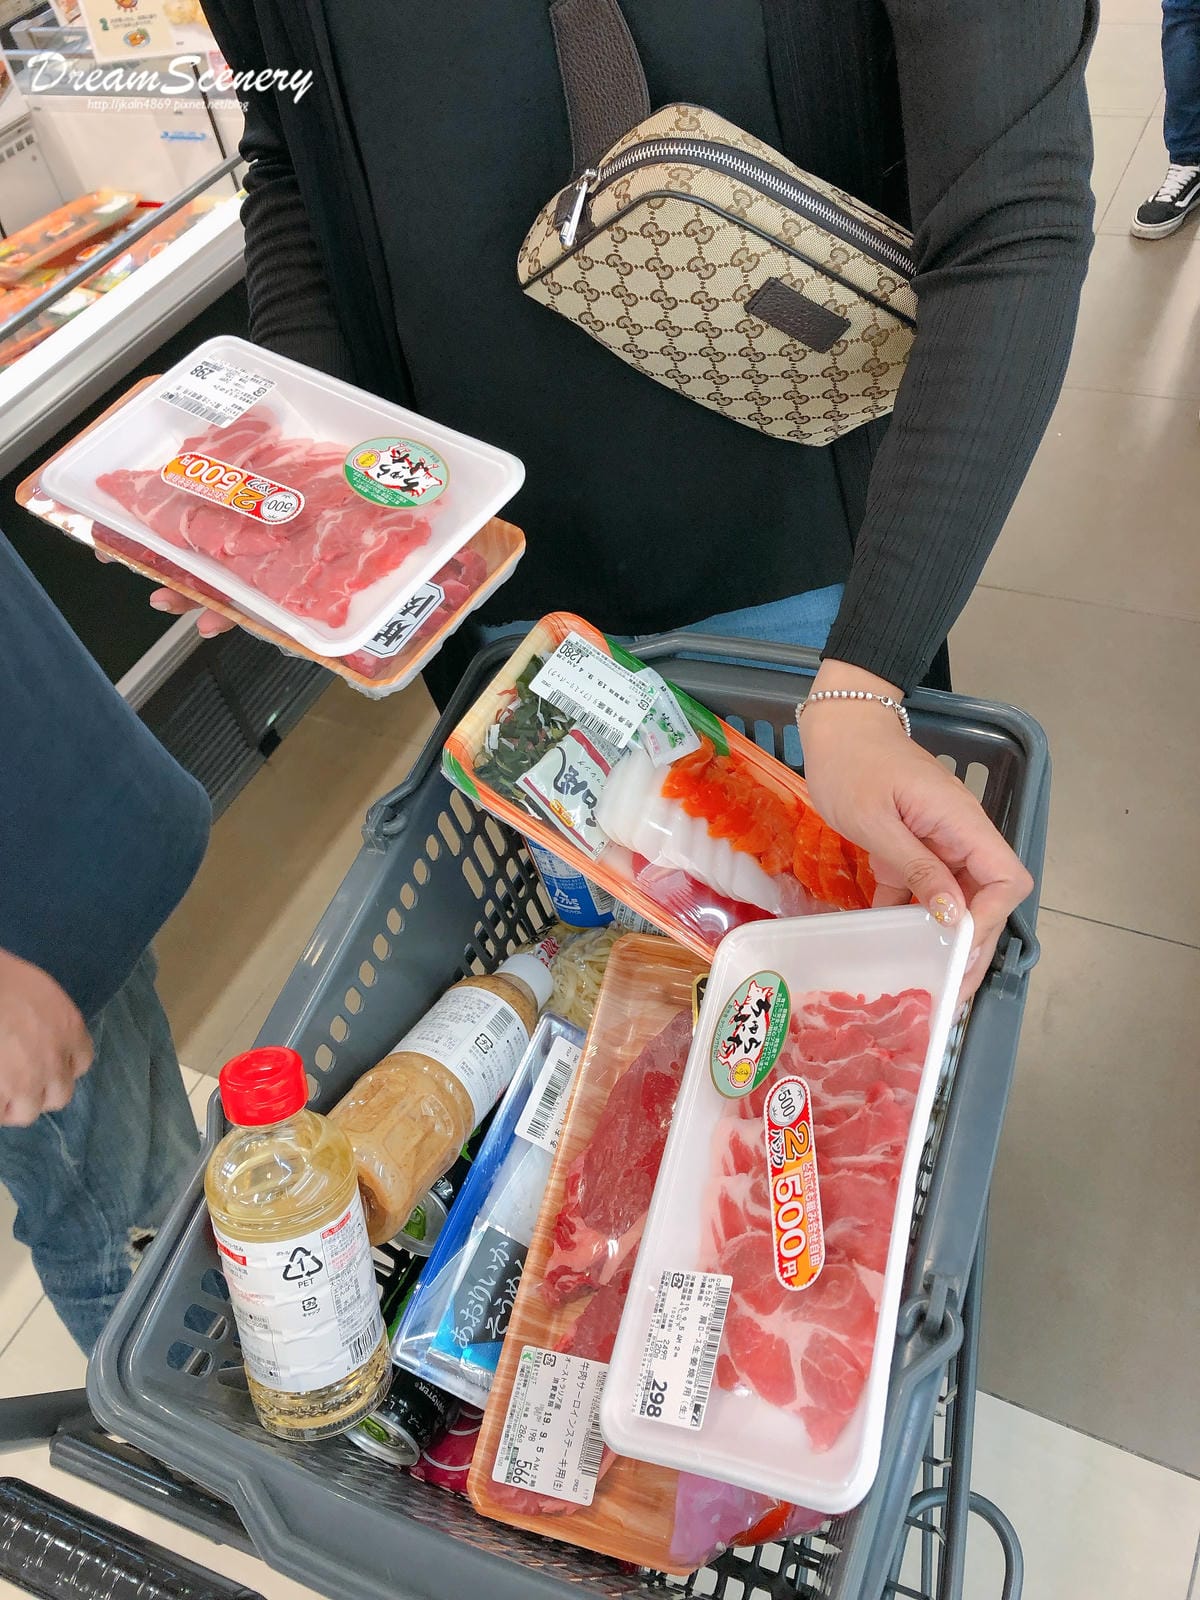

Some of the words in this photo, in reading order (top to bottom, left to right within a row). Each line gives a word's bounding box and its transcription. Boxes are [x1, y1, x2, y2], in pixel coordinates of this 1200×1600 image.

[188, 363, 215, 380] 298
[179, 455, 243, 493] 500円
[376, 465, 419, 491] ちゅら
[231, 484, 266, 512] 2
[267, 497, 292, 512] 500
[558, 642, 584, 665] 1280
[743, 998, 771, 1054] ちゅら
[776, 1088, 796, 1118] 500
[770, 1129, 785, 1166] パック
[782, 1121, 811, 1161] 2
[773, 1173, 809, 1279] 500円
[298, 1277, 314, 1289] PET
[450, 1241, 511, 1349] あおりいか
[659, 1338, 670, 1361] 249円
[546, 1376, 559, 1408] 消費期限
[553, 1355, 571, 1411] オーストラリア産
[644, 1378, 668, 1419] 298
[541, 1410, 552, 1427] 19.
[527, 1426, 537, 1442] 198
[538, 1430, 547, 1442] 9.
[532, 1456, 540, 1471] AM
[535, 1445, 544, 1454] 5
[511, 1457, 532, 1487] 566
